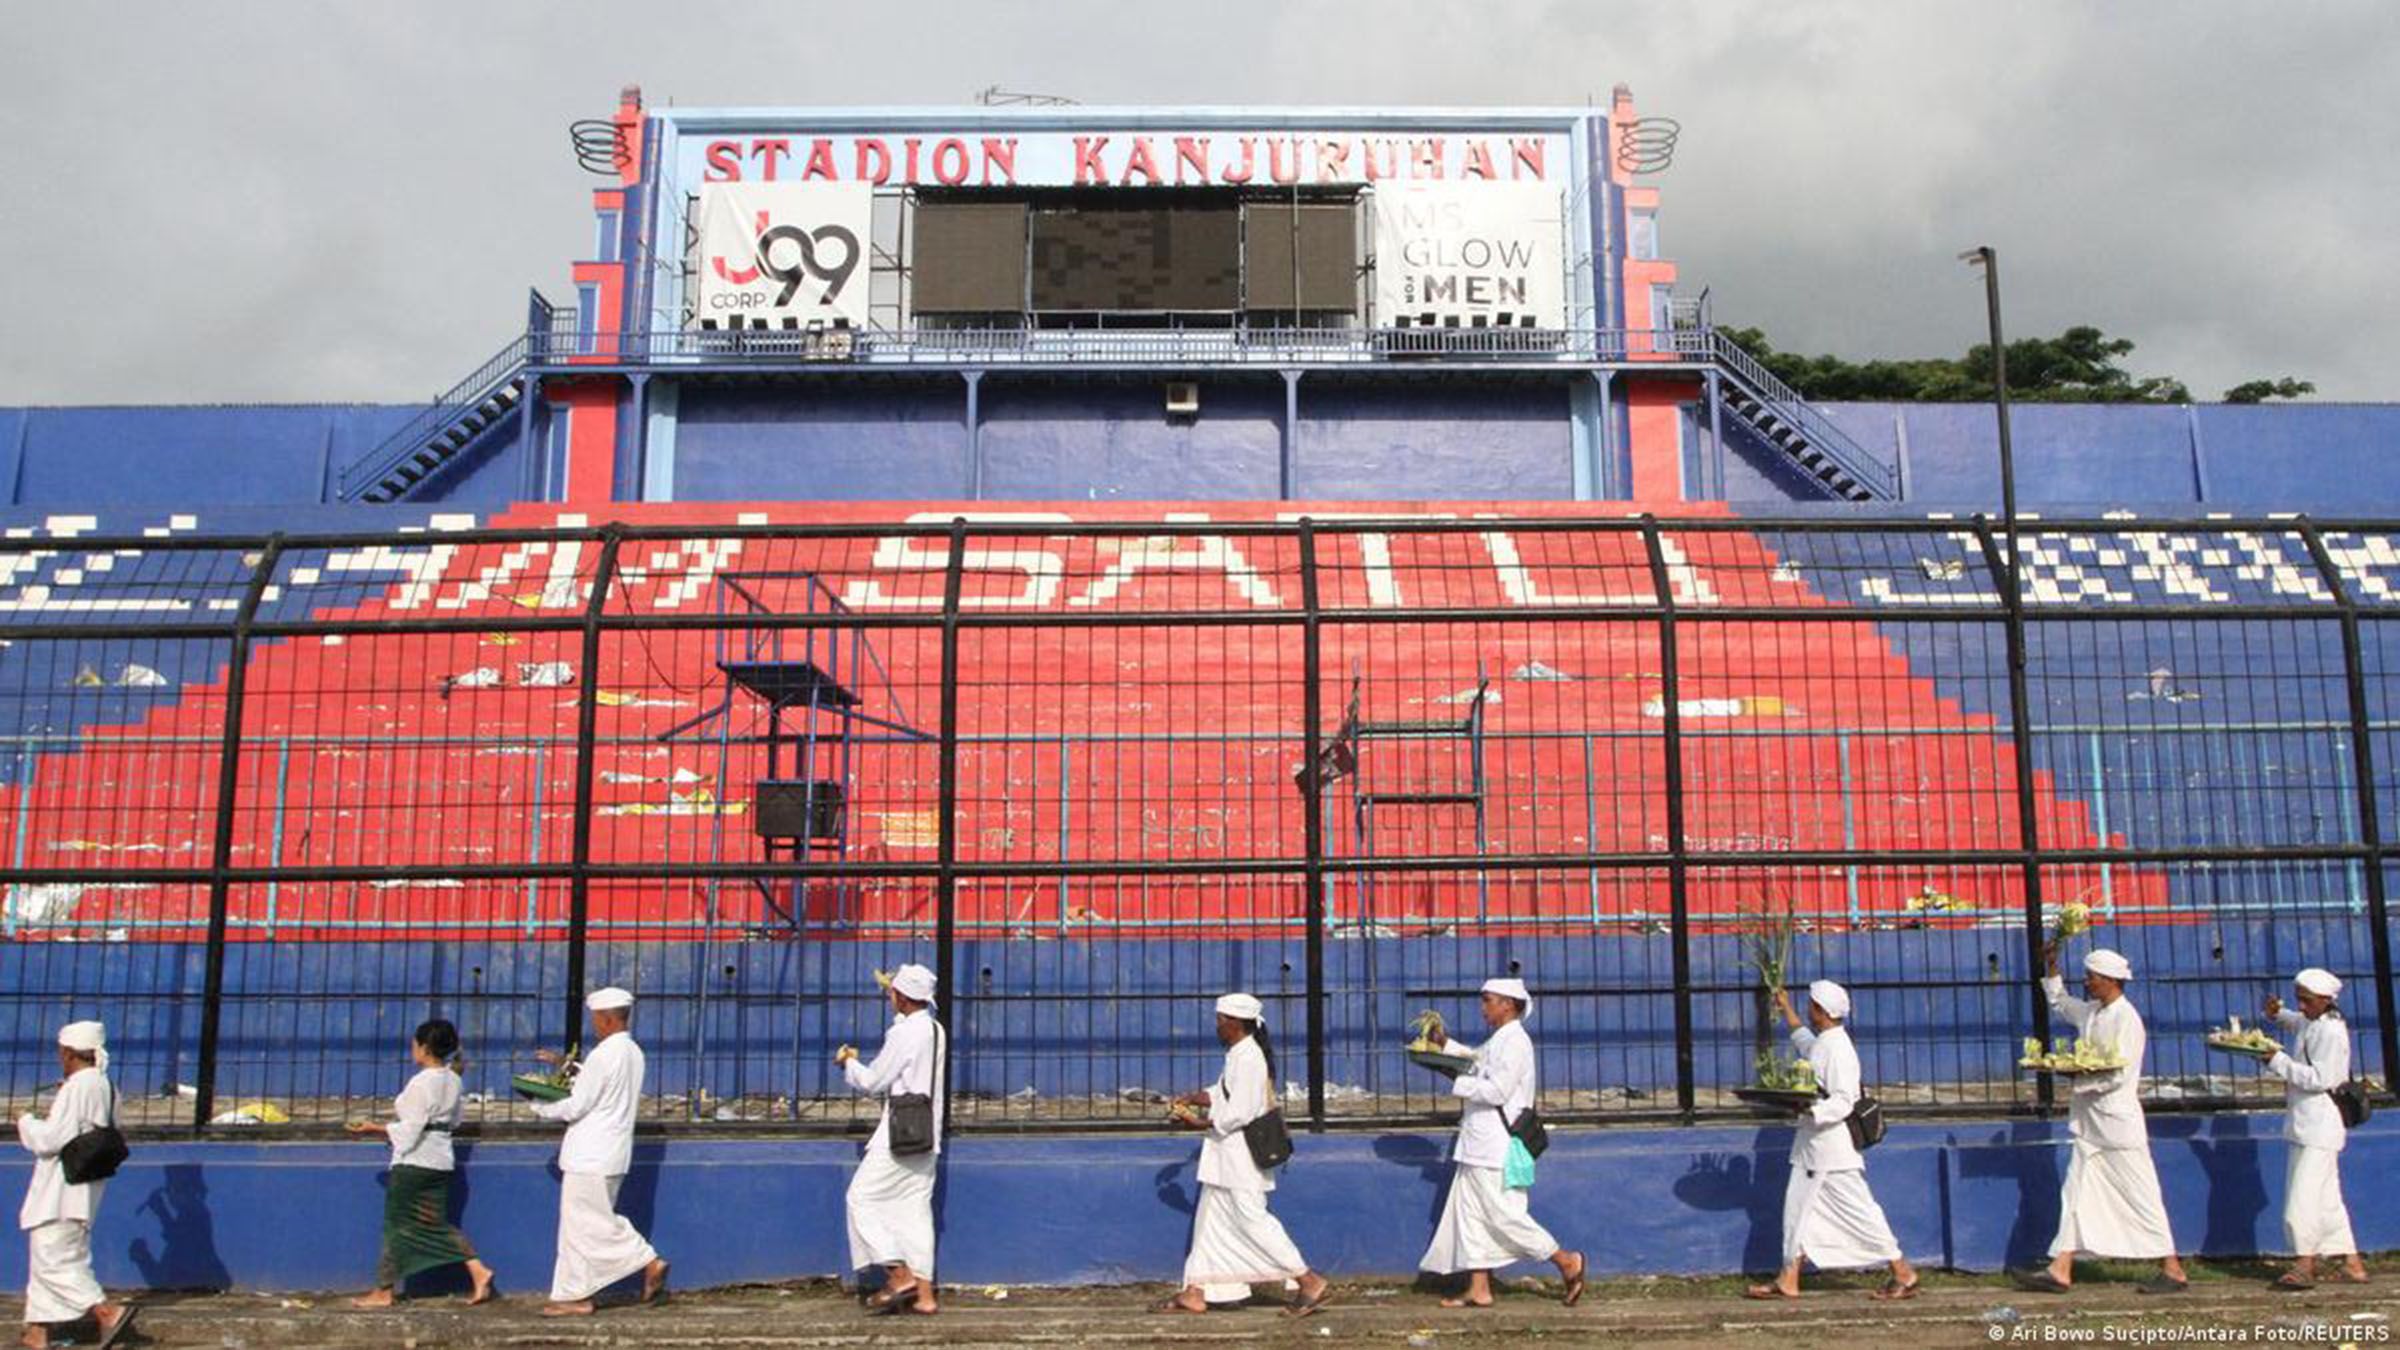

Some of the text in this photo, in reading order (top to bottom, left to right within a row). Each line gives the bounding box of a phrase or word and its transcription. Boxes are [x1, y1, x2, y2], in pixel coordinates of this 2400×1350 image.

[704, 137, 1545, 187] STADION KANJURUHAN
[1403, 238, 1535, 268] GLOW
[1424, 275, 1526, 305] MEN
